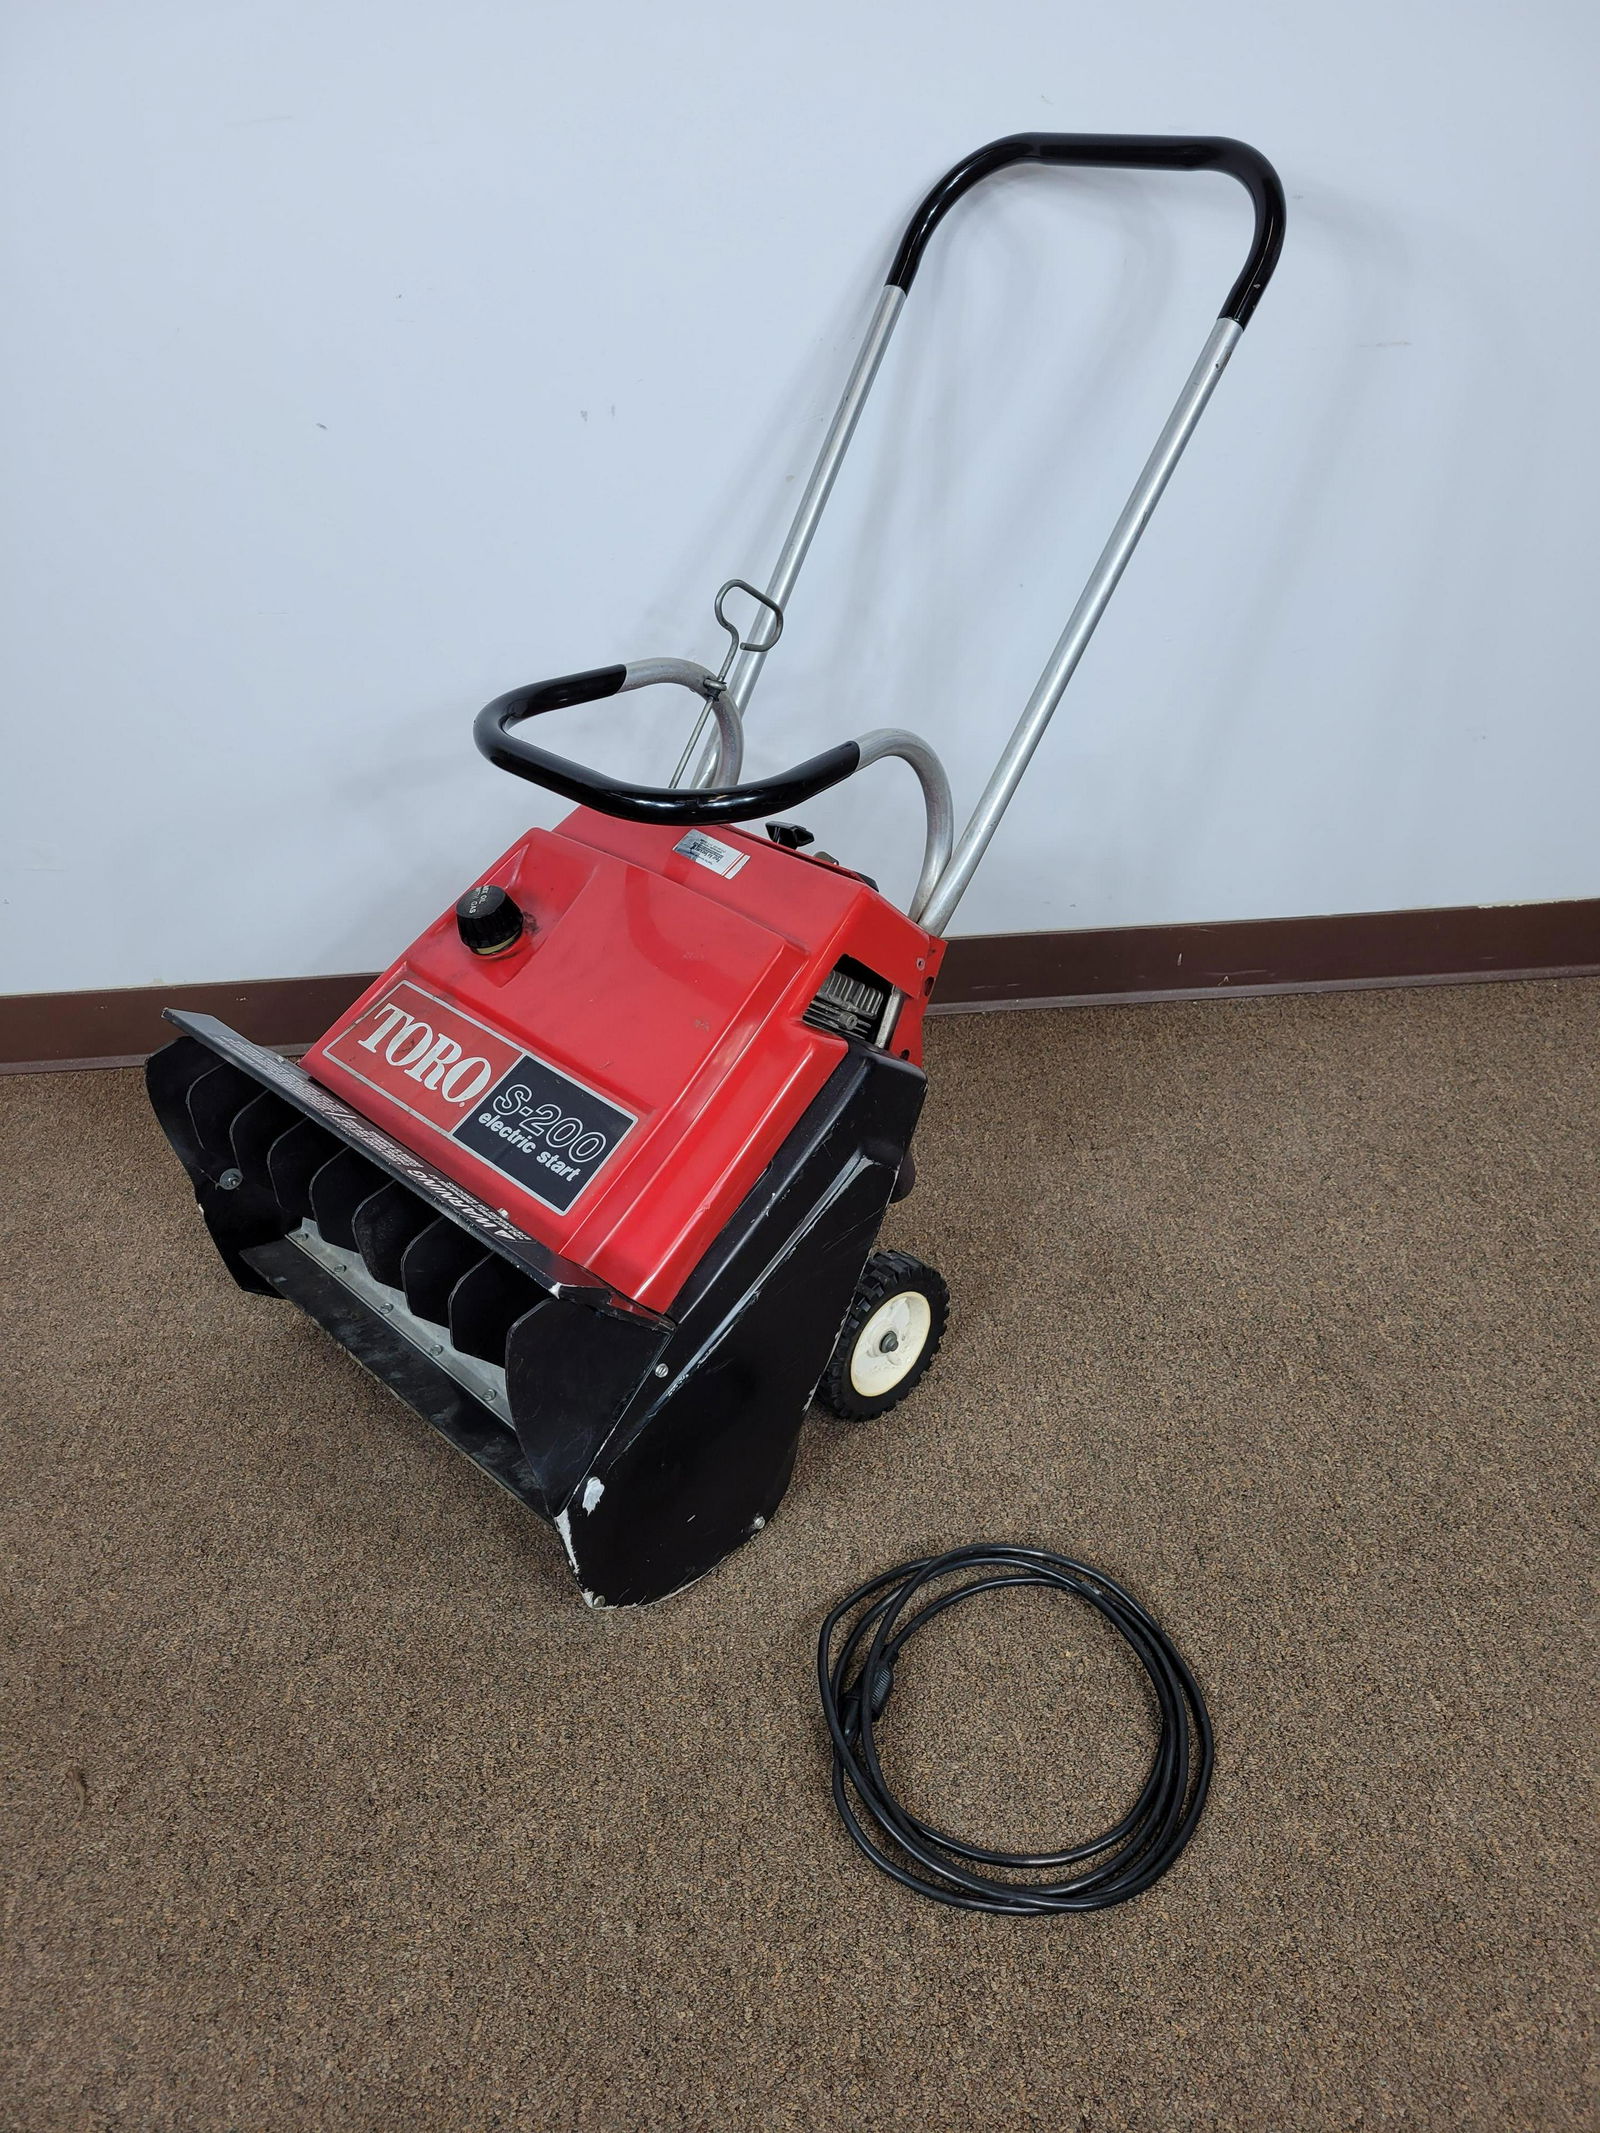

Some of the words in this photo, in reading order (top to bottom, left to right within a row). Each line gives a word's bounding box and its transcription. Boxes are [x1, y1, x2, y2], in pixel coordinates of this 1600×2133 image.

[357, 1002, 492, 1104] TORO
[478, 1112, 537, 1154] electric
[536, 1151, 581, 1182] start
[492, 1083, 607, 1163] S-200
[406, 1168, 498, 1228] WARNING
